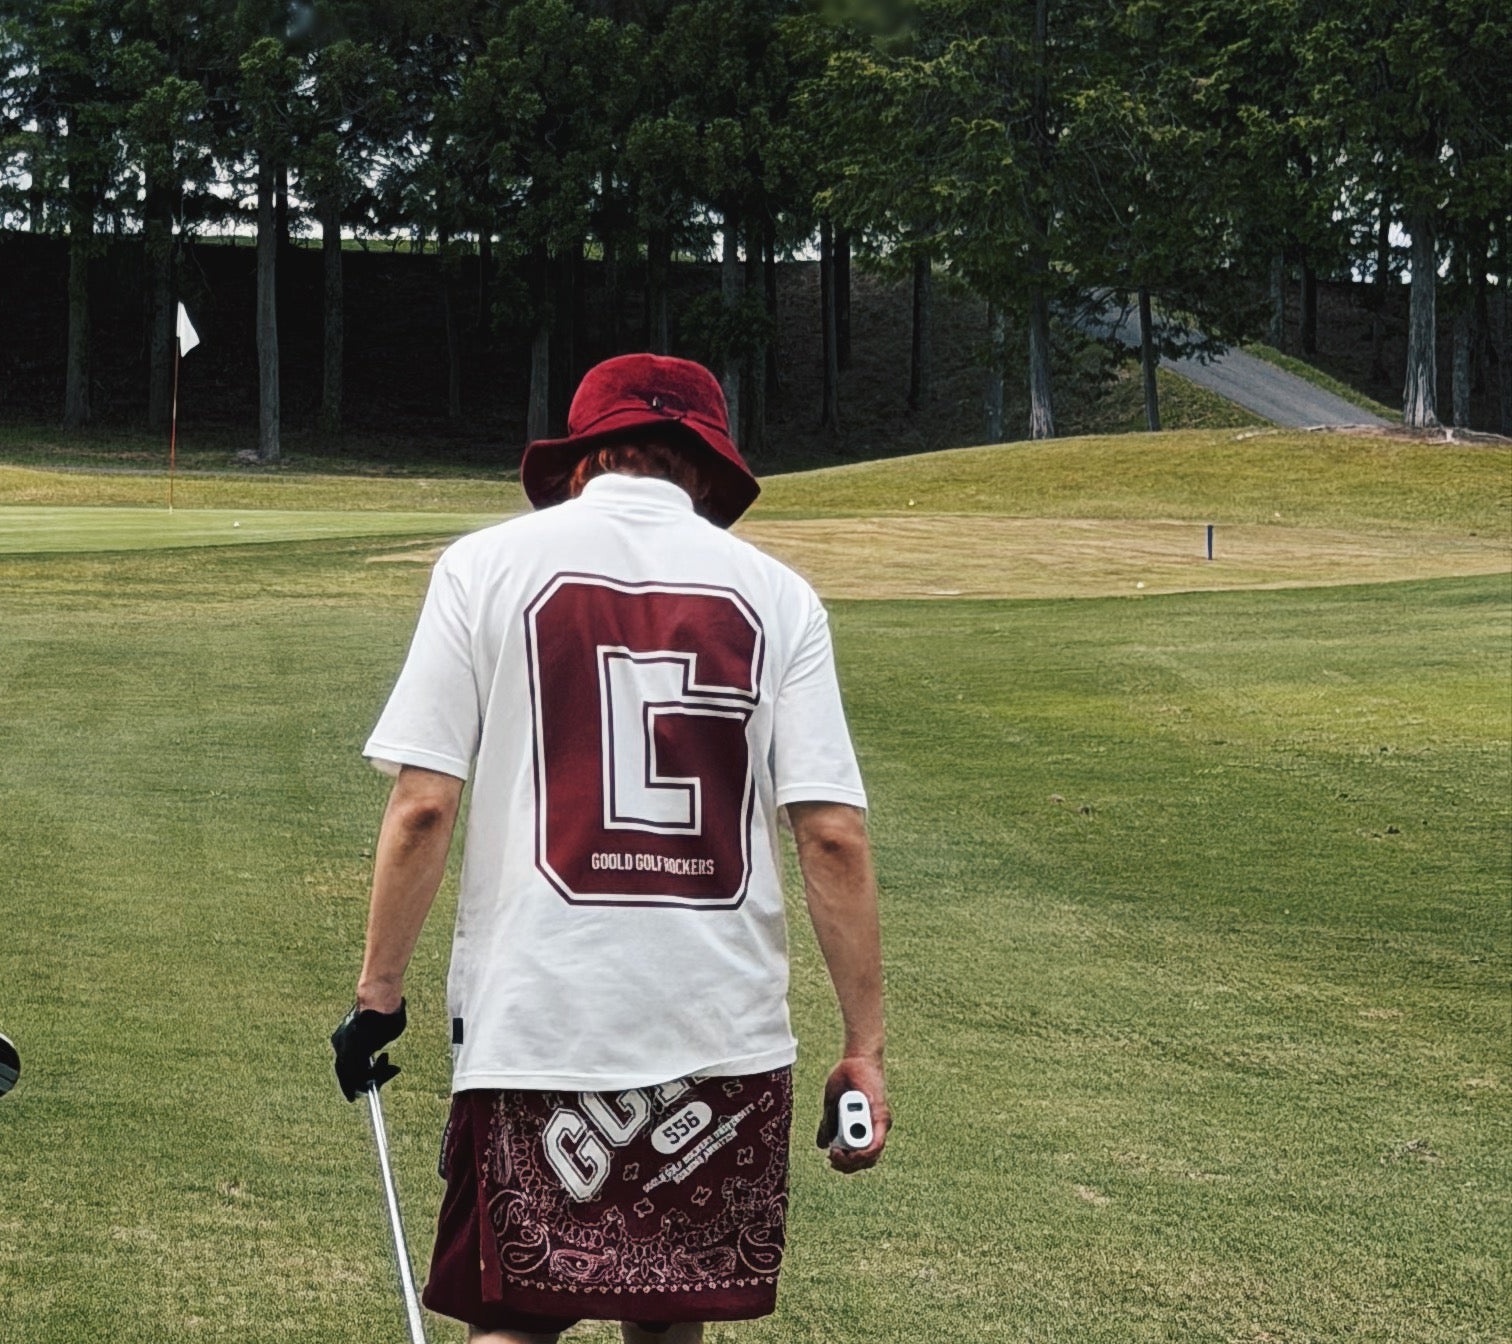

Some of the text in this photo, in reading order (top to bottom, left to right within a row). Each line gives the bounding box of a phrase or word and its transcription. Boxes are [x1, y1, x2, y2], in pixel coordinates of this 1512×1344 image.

[523, 572, 766, 911] G
[591, 852, 715, 876] GOOLD GOLF ROCKERS
[662, 1109, 701, 1145] 556
